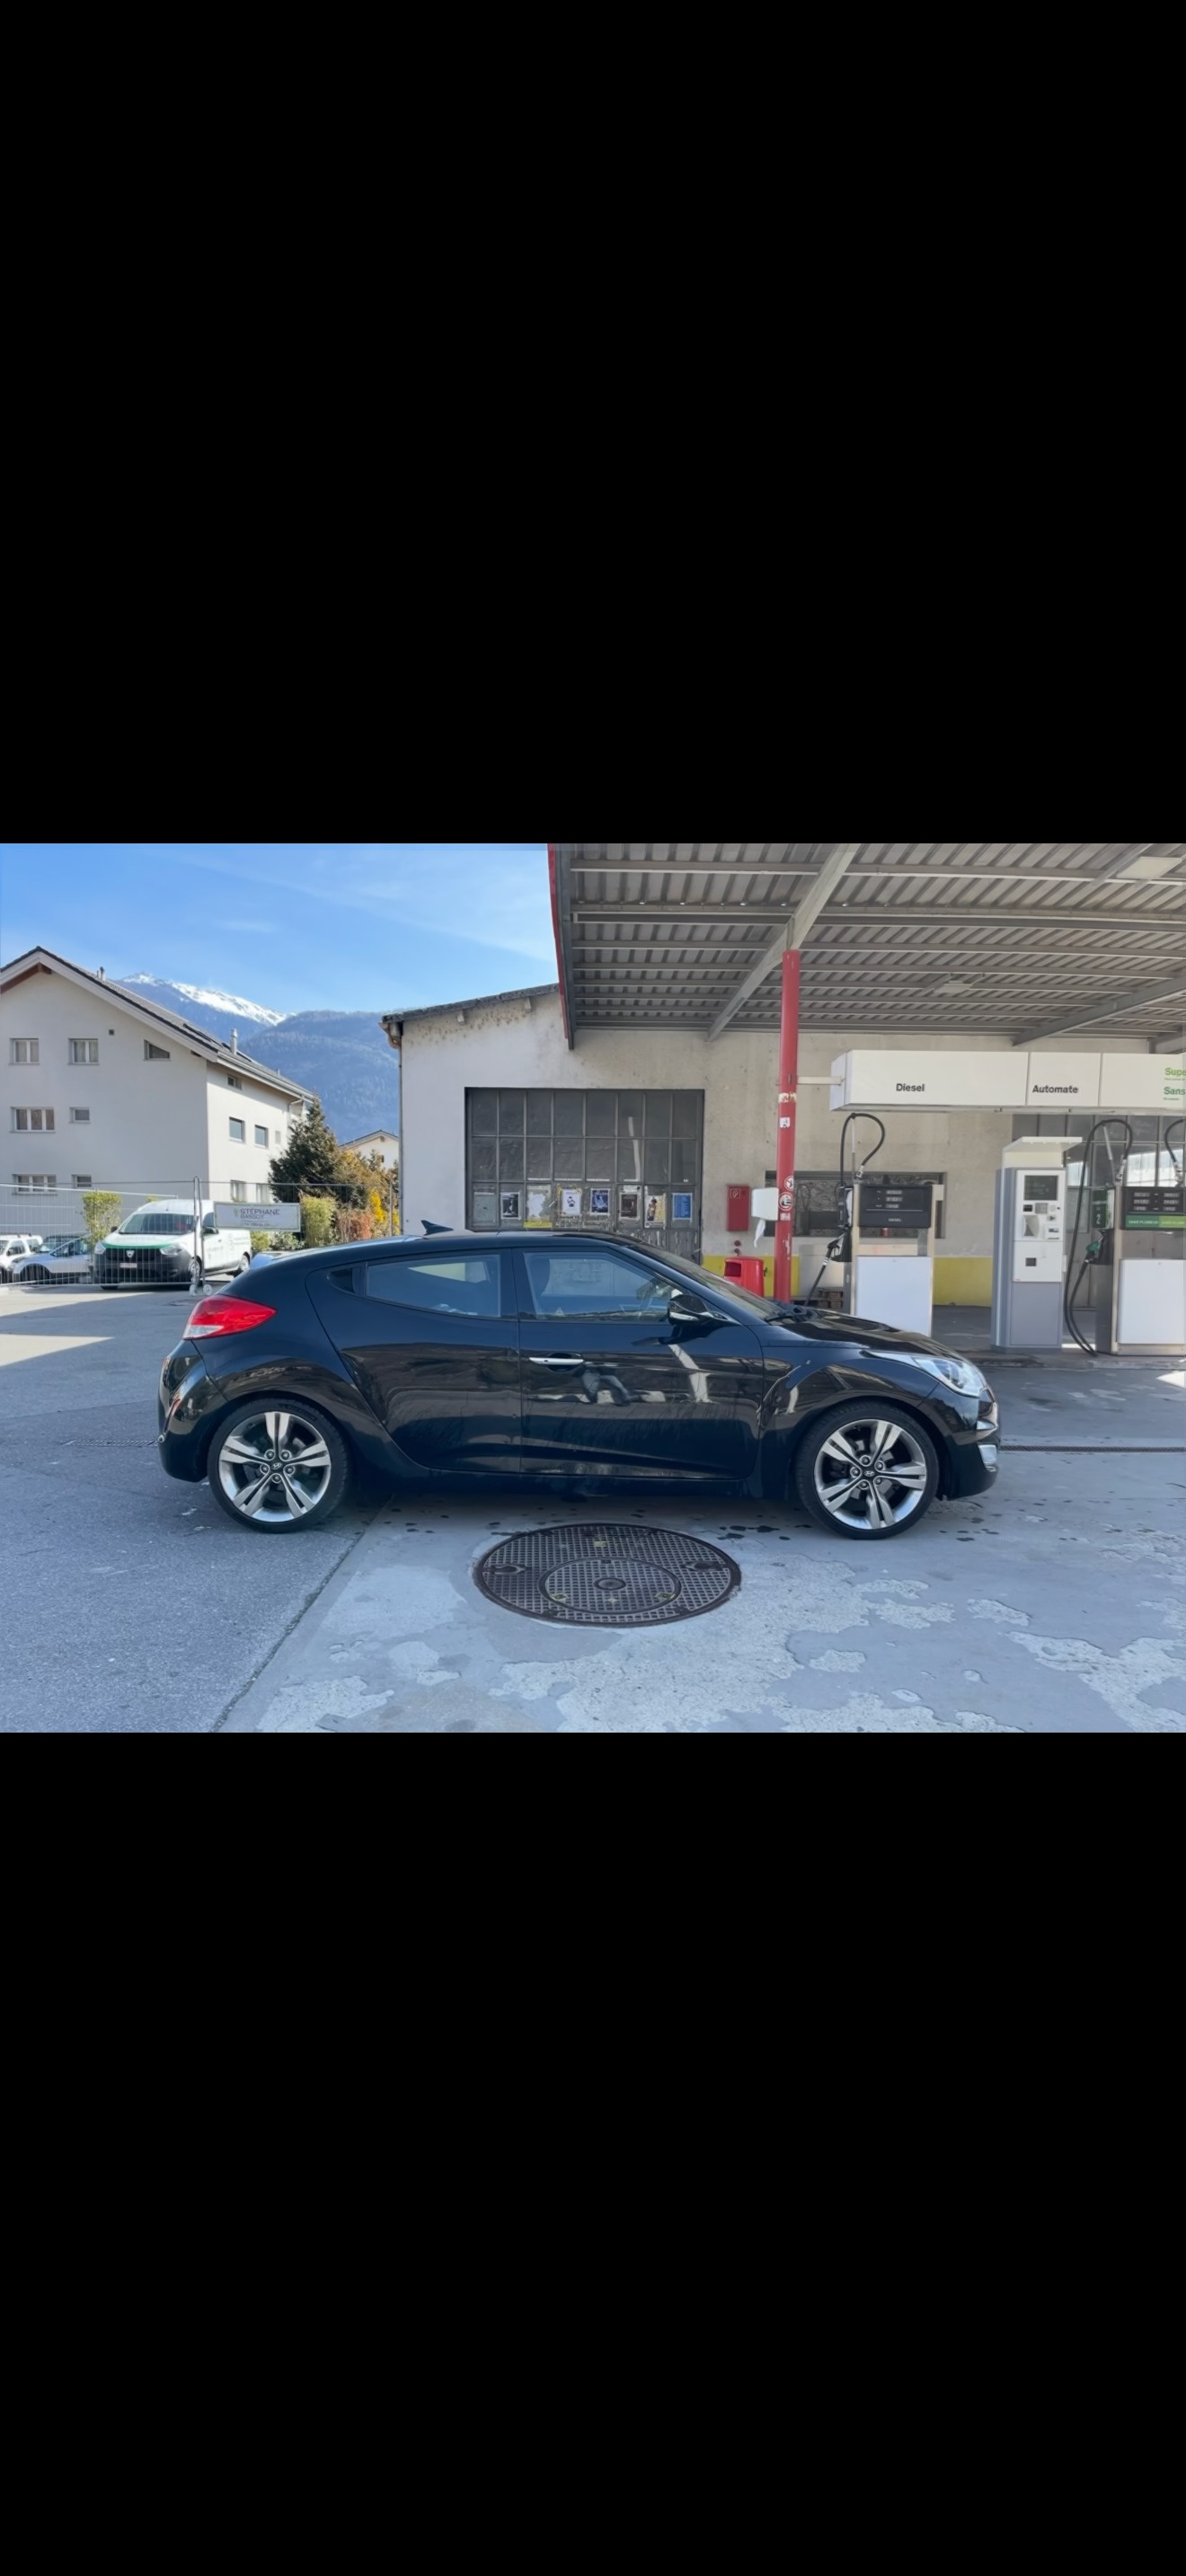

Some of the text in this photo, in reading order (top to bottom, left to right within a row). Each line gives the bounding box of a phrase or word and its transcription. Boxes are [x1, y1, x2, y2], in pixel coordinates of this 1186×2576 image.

[896, 1083, 925, 1092] Diesel
[1032, 1085, 1078, 1094] Automate
[1164, 1086, 1186, 1096] Sans
